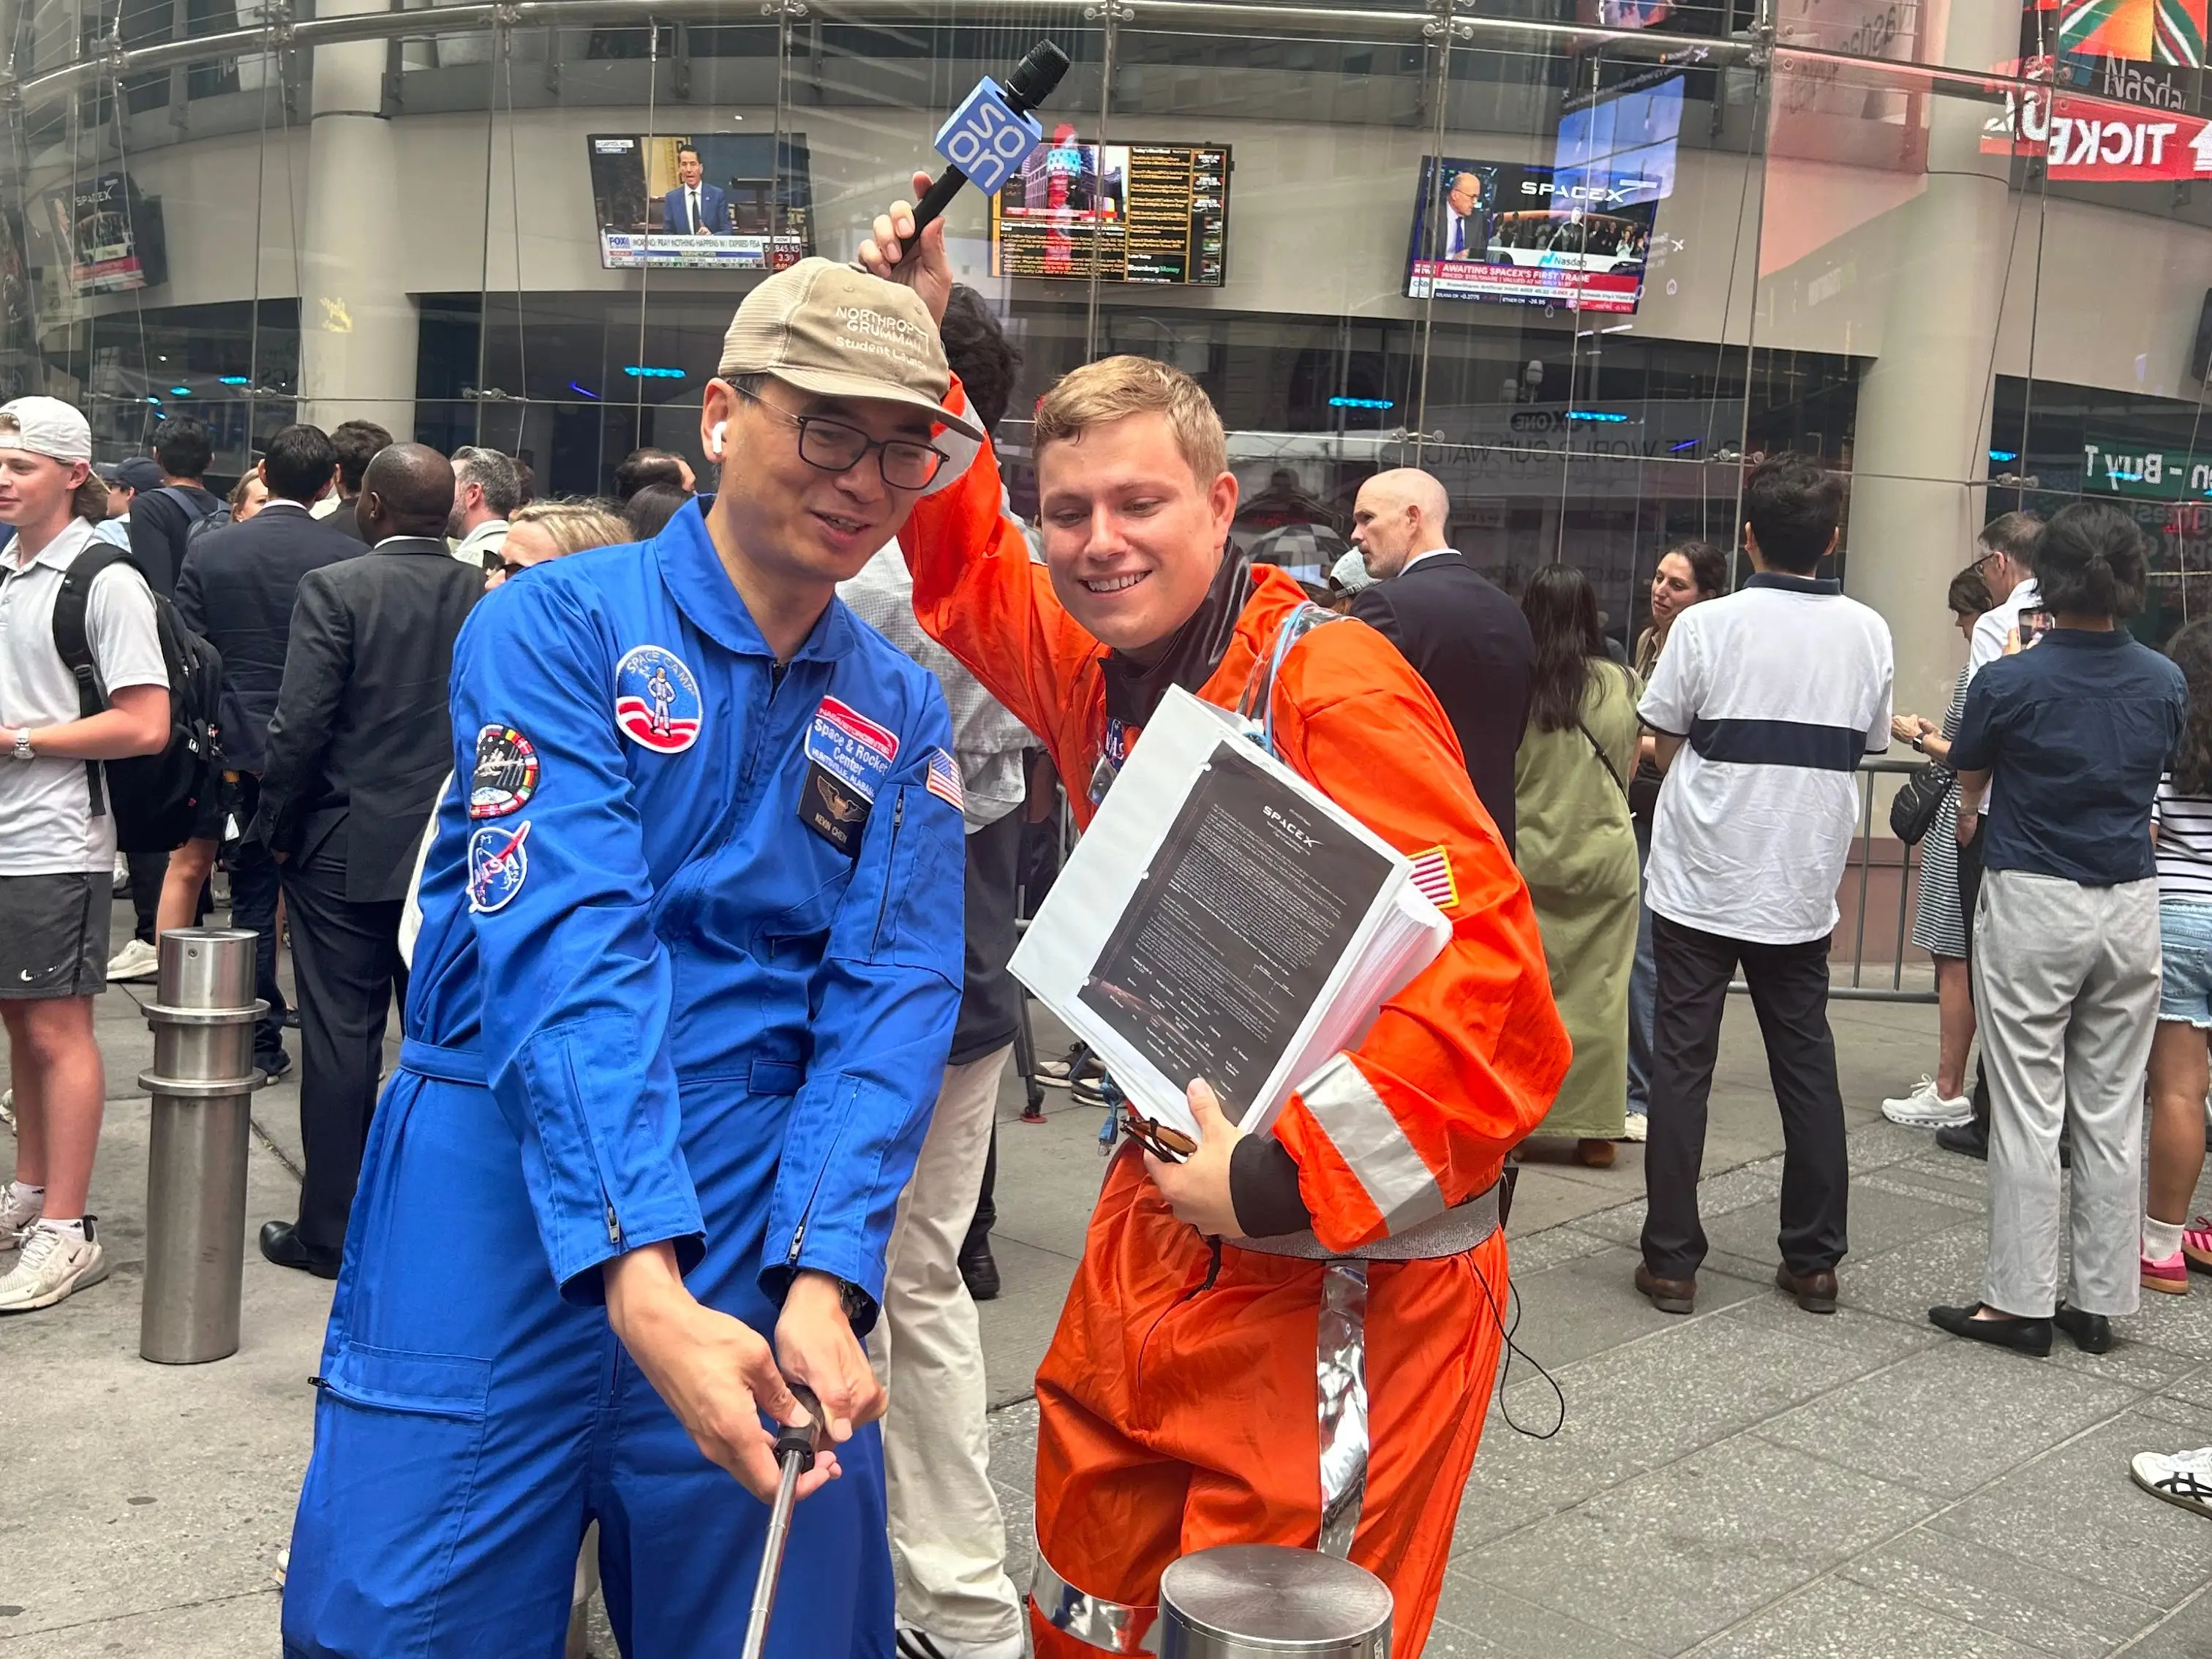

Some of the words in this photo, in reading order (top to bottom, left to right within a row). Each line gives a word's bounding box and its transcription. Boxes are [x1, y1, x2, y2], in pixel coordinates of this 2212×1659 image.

[2104, 49, 2186, 110] Nasda
[1521, 182, 1630, 203] SPACEX
[609, 236, 625, 246] FOX
[1442, 264, 1488, 275] AWAITING
[1489, 266, 1532, 279] SPACEX'S
[1532, 270, 1559, 280] FIRST
[1554, 257, 1587, 268] Nasdaq
[836, 306, 914, 334] NORTHROP
[835, 336, 890, 357] Student
[626, 650, 661, 674] SPACE
[814, 718, 845, 747] Space
[845, 739, 854, 753] &
[855, 744, 889, 776] Rocket
[832, 746, 865, 775] Center
[814, 812, 832, 832] KEVIN
[832, 827, 848, 844] CHEN
[1263, 805, 1320, 848] SPACEX
